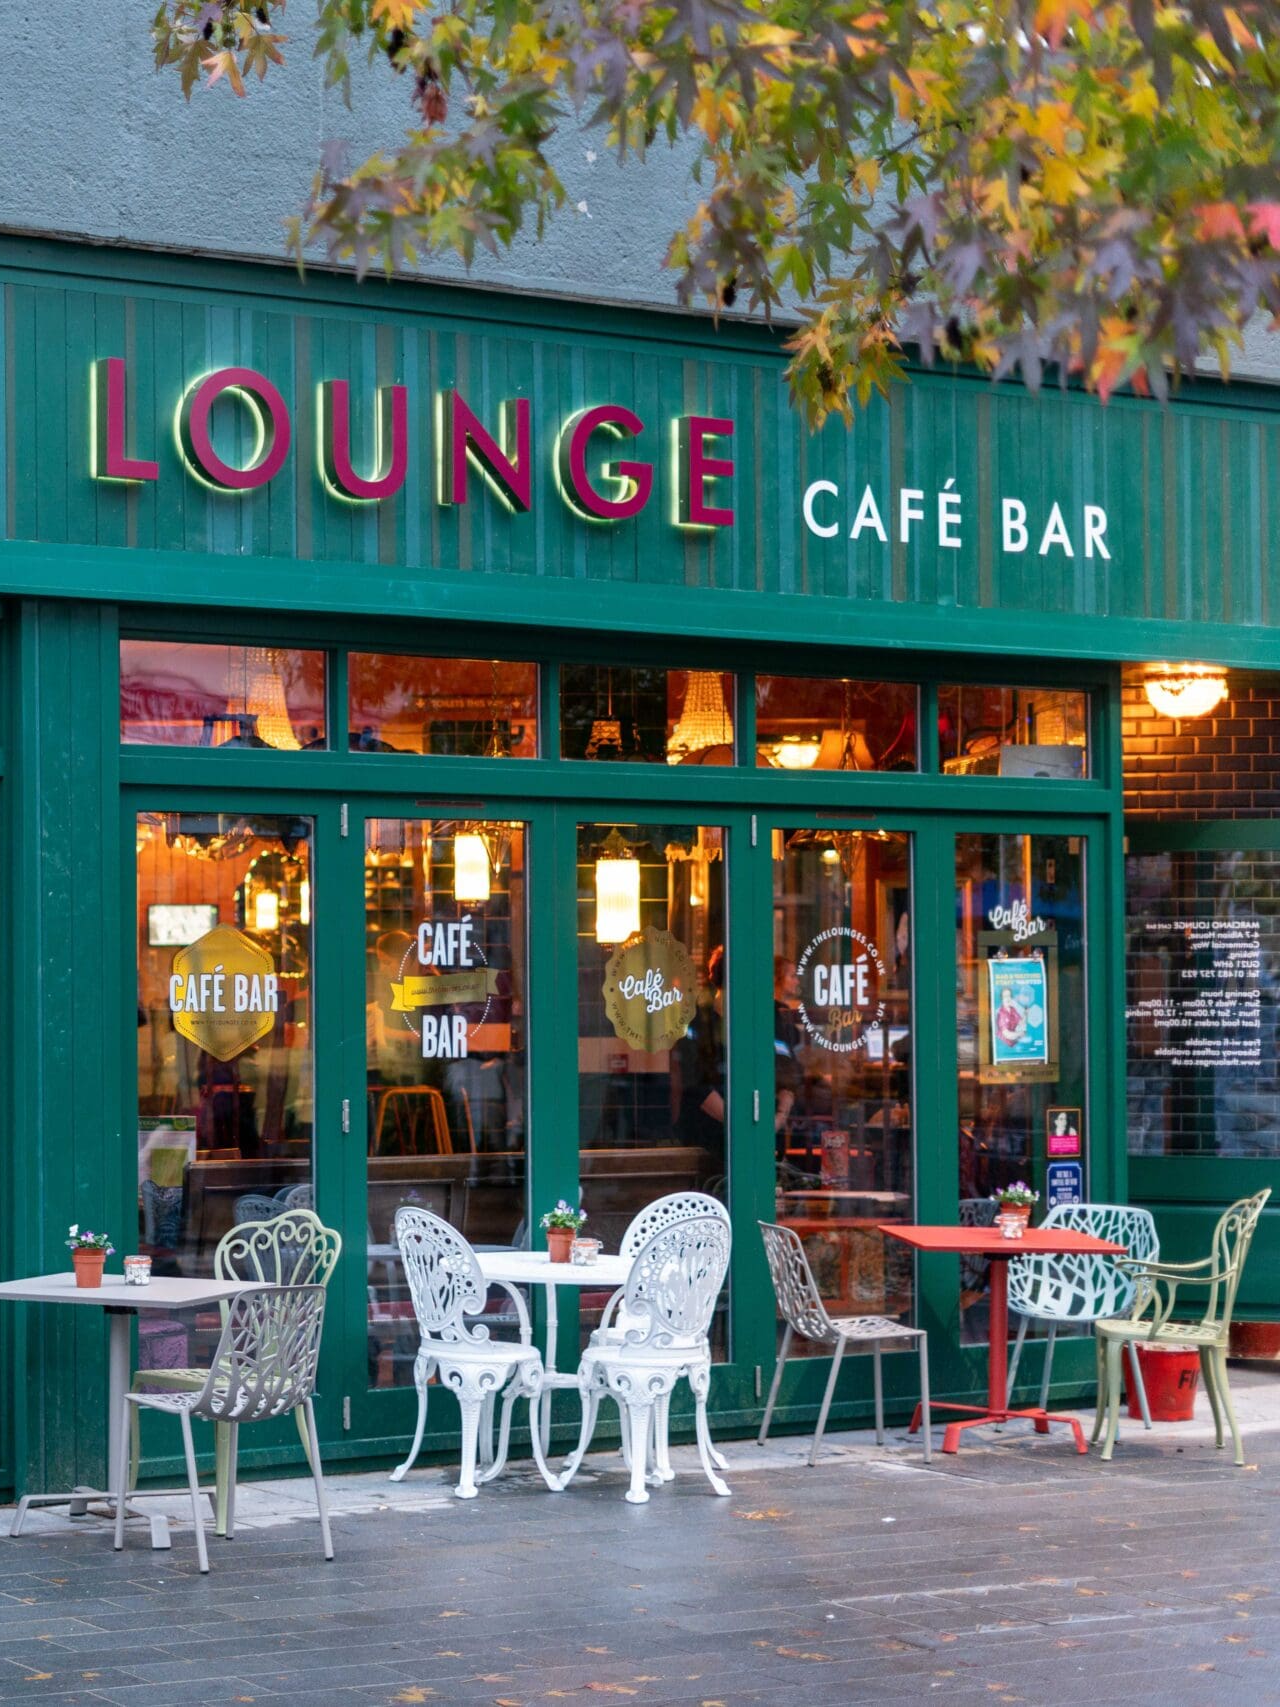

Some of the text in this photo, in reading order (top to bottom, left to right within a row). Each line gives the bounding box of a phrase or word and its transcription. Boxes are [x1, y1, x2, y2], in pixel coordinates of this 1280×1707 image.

[90, 356, 734, 527] LOUNGE
[802, 478, 1112, 560] CAFÉ BAR
[988, 898, 1030, 930] Café
[1013, 915, 1046, 942] Bar
[418, 914, 473, 967] CAFÉ
[796, 926, 887, 977] WWW.THELOUNGES.CO.UK
[169, 964, 279, 1013] CAFÉ BAR
[618, 967, 665, 1001] Café
[646, 986, 684, 1014] Bar
[813, 953, 870, 1006] CAFÉ
[422, 1014, 468, 1059] BAR
[797, 1001, 887, 1053] WWW.THELOUNGESCO.UK
[826, 1007, 863, 1036] Bar
